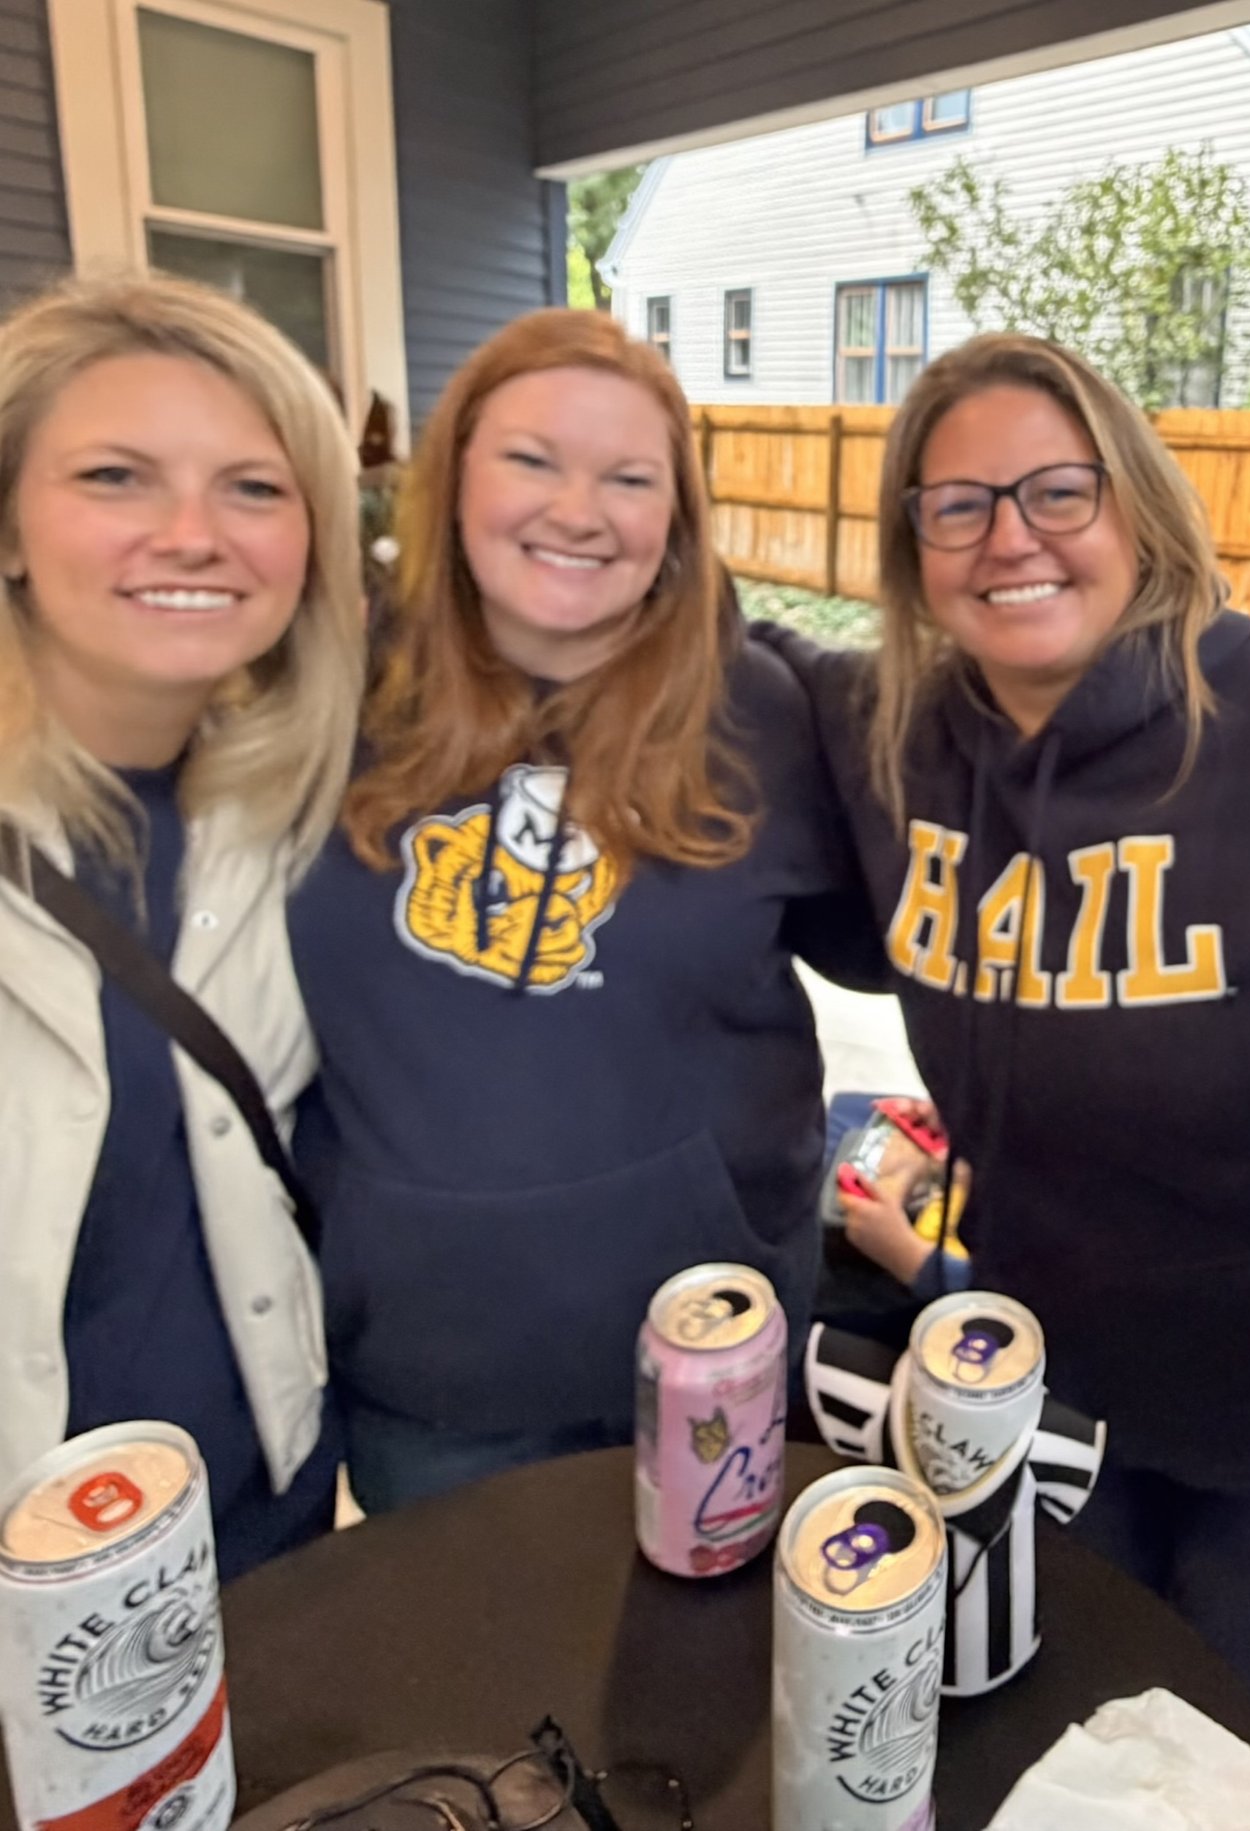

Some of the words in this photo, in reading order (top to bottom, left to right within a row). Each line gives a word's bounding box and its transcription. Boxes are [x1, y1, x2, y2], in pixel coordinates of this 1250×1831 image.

[886, 818, 1226, 1010] HAIL
[919, 1412, 997, 1473] CLAW
[37, 1612, 116, 1717] WHITE
[124, 1538, 208, 1609] CLA
[81, 1708, 167, 1741] HARD
[828, 1668, 897, 1763] WHITE
[858, 1765, 918, 1795] HARD
